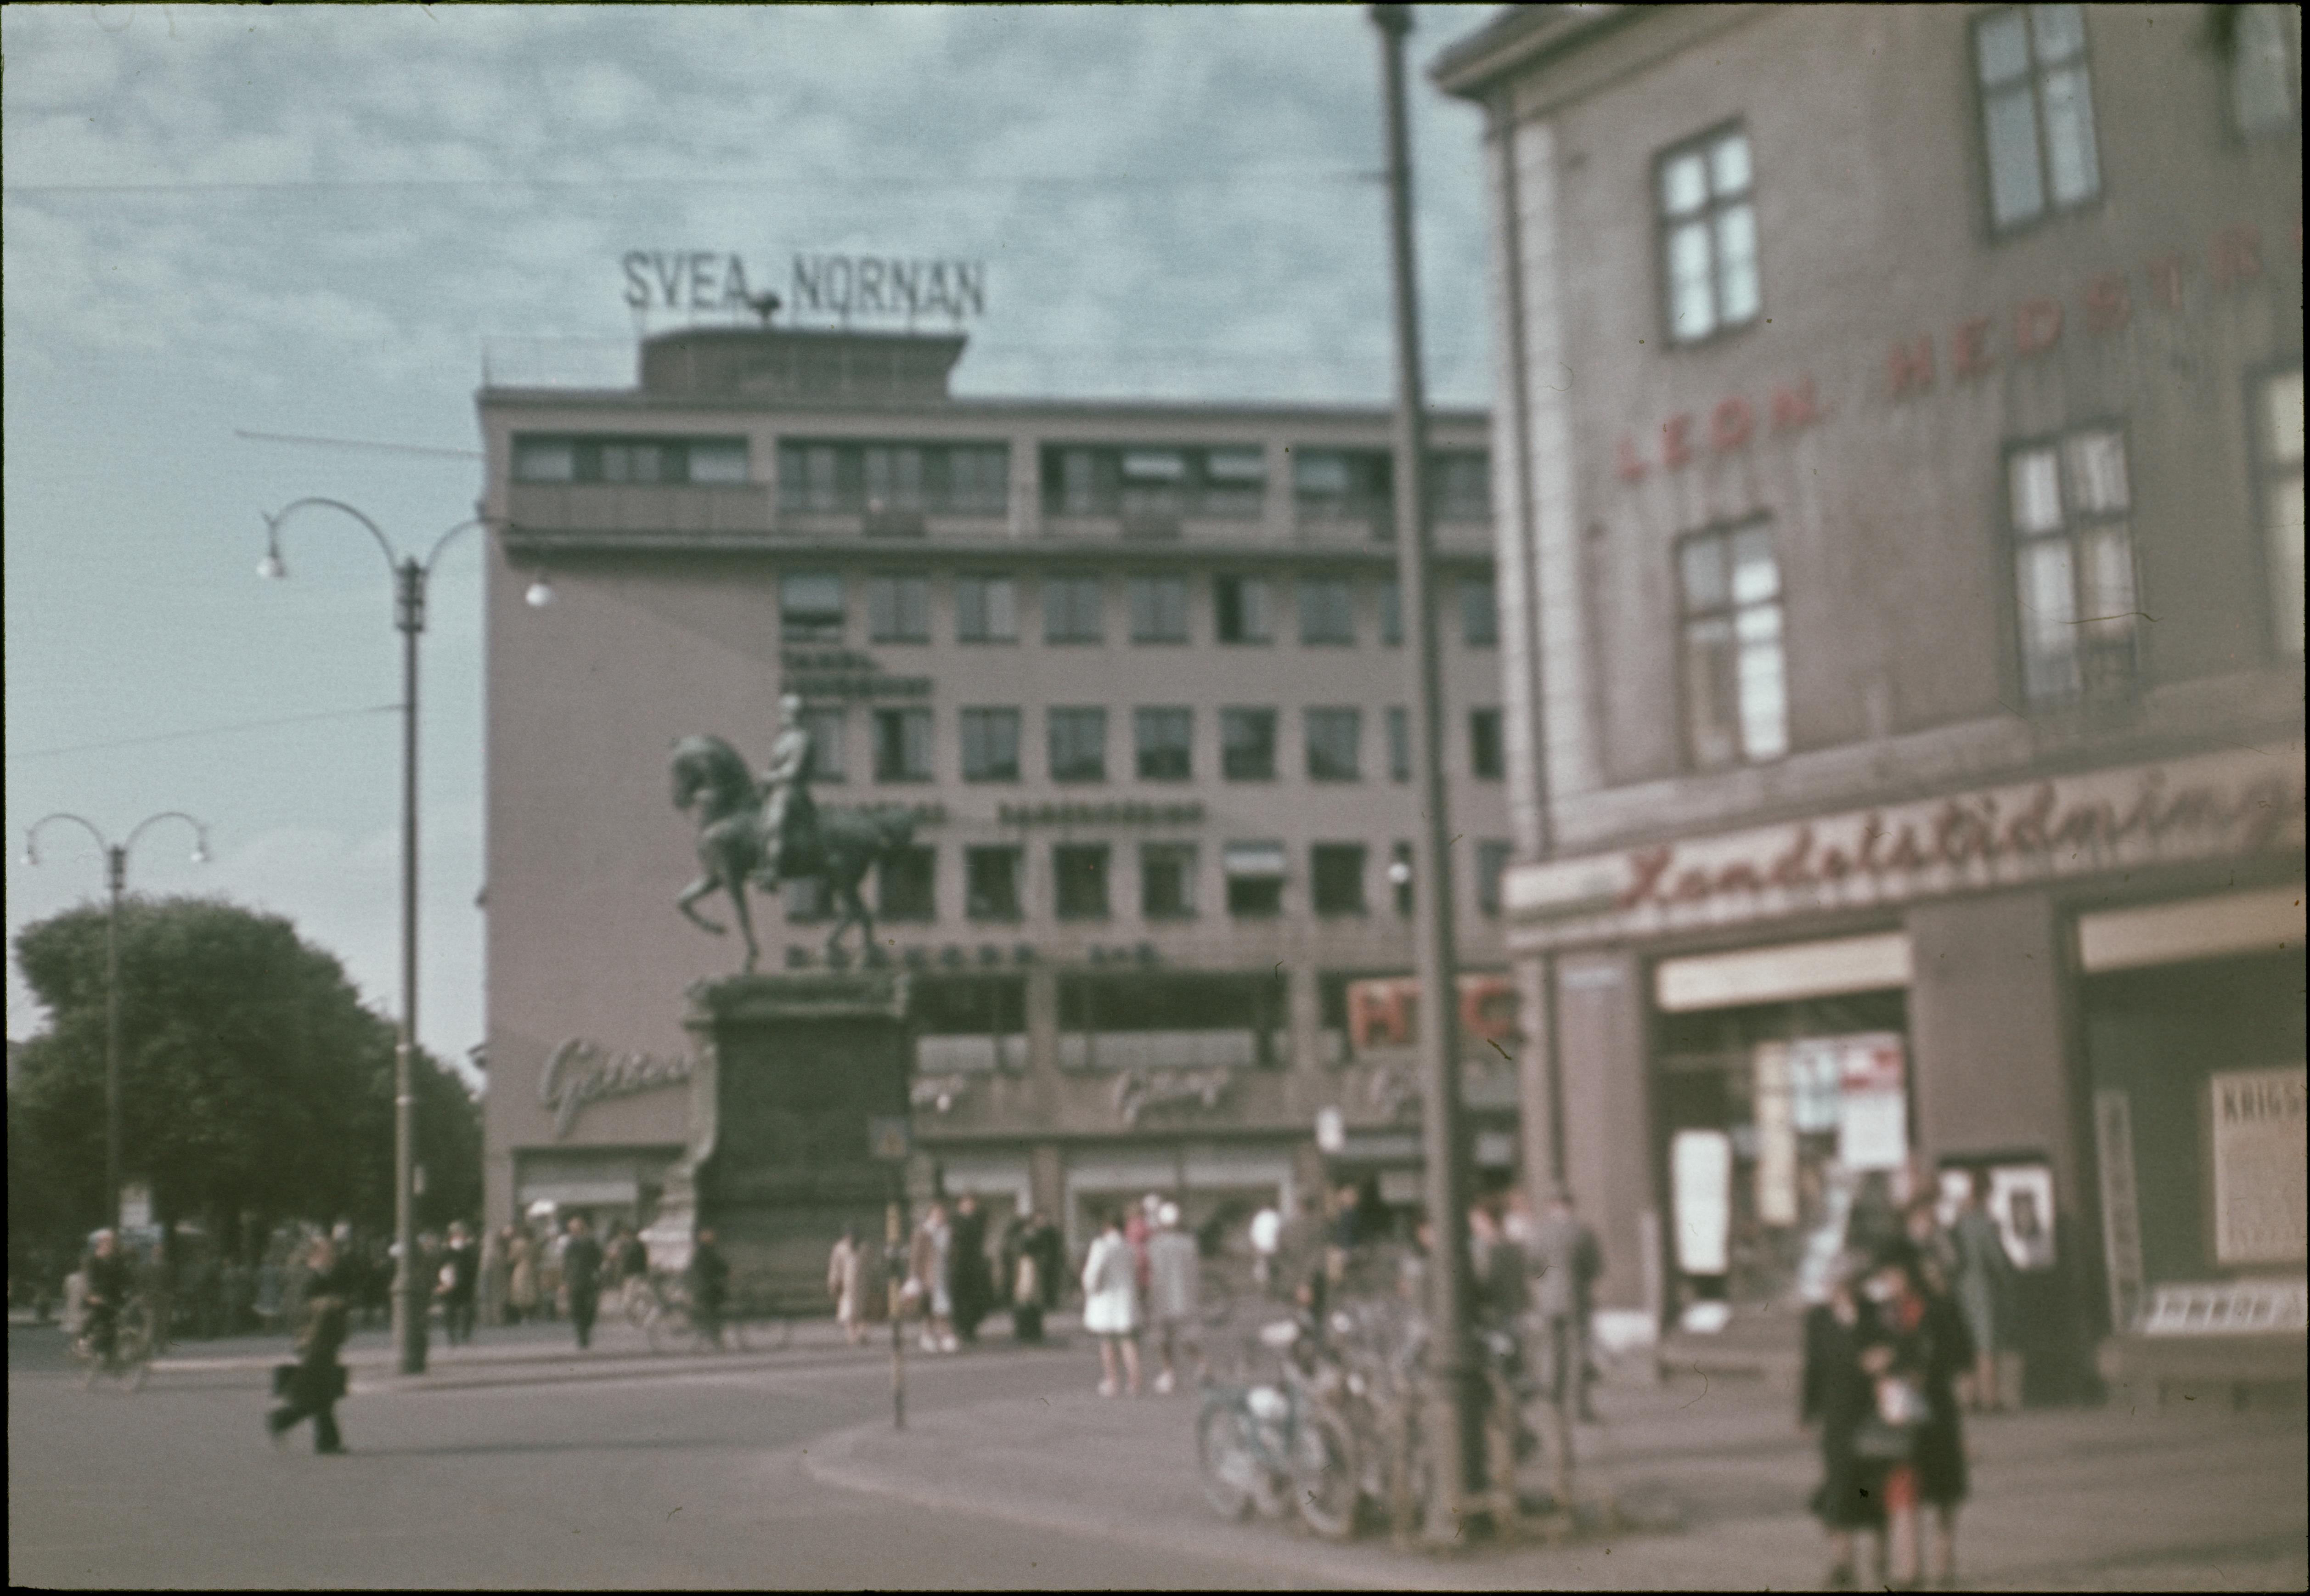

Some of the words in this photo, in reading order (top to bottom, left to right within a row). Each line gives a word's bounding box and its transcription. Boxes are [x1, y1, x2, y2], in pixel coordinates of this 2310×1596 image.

[622, 249, 749, 310] SVEA
[793, 252, 986, 315] NORNAN
[1612, 371, 1821, 486] LEON
[1884, 220, 2303, 402] HEDSTR
